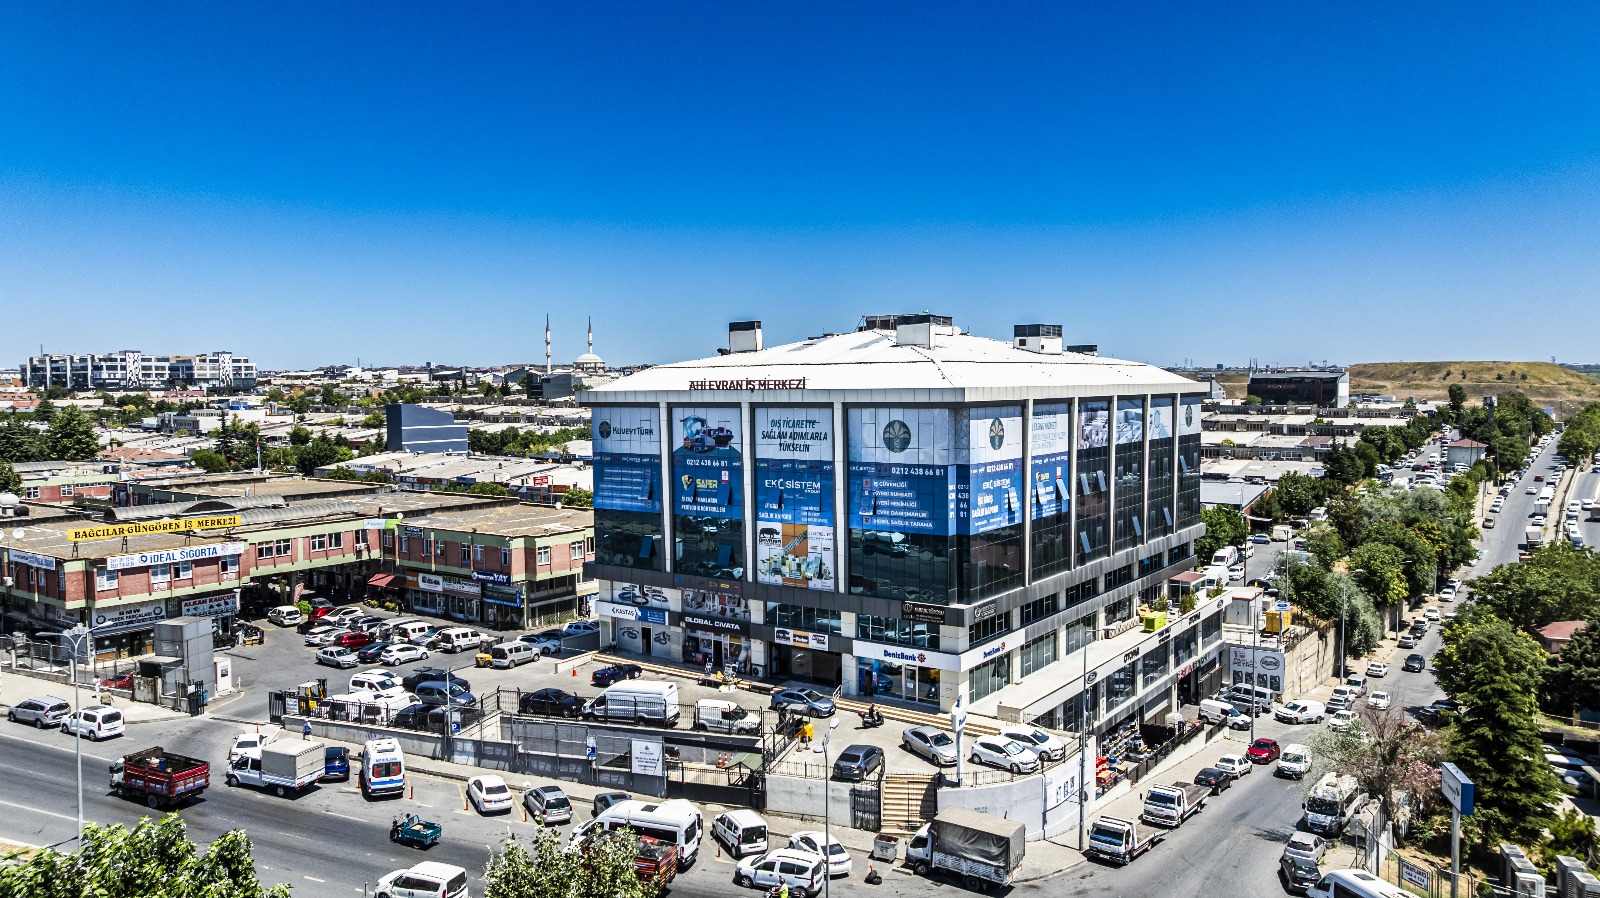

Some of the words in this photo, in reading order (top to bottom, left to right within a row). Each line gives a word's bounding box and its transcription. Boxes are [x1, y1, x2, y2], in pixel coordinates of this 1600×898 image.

[689, 378, 706, 390] AHİ
[708, 380, 742, 390] EVRAN
[745, 378, 756, 392] İŞ
[758, 376, 806, 390] MERKEZİ
[782, 416, 816, 428] TİCARETTE
[761, 428, 788, 440] SAĞLAM
[788, 432, 828, 441] ADIMLARLA
[778, 440, 810, 452] YÜKSELİN
[786, 479, 820, 490] SİSTEM
[184, 520, 193, 530] İŞ
[196, 516, 236, 528] MERKEZİ
[493, 573, 508, 582] YAY
[184, 600, 208, 608] ALKAN
[684, 616, 714, 626] GLOBAL
[884, 650, 916, 662] DenizBank
